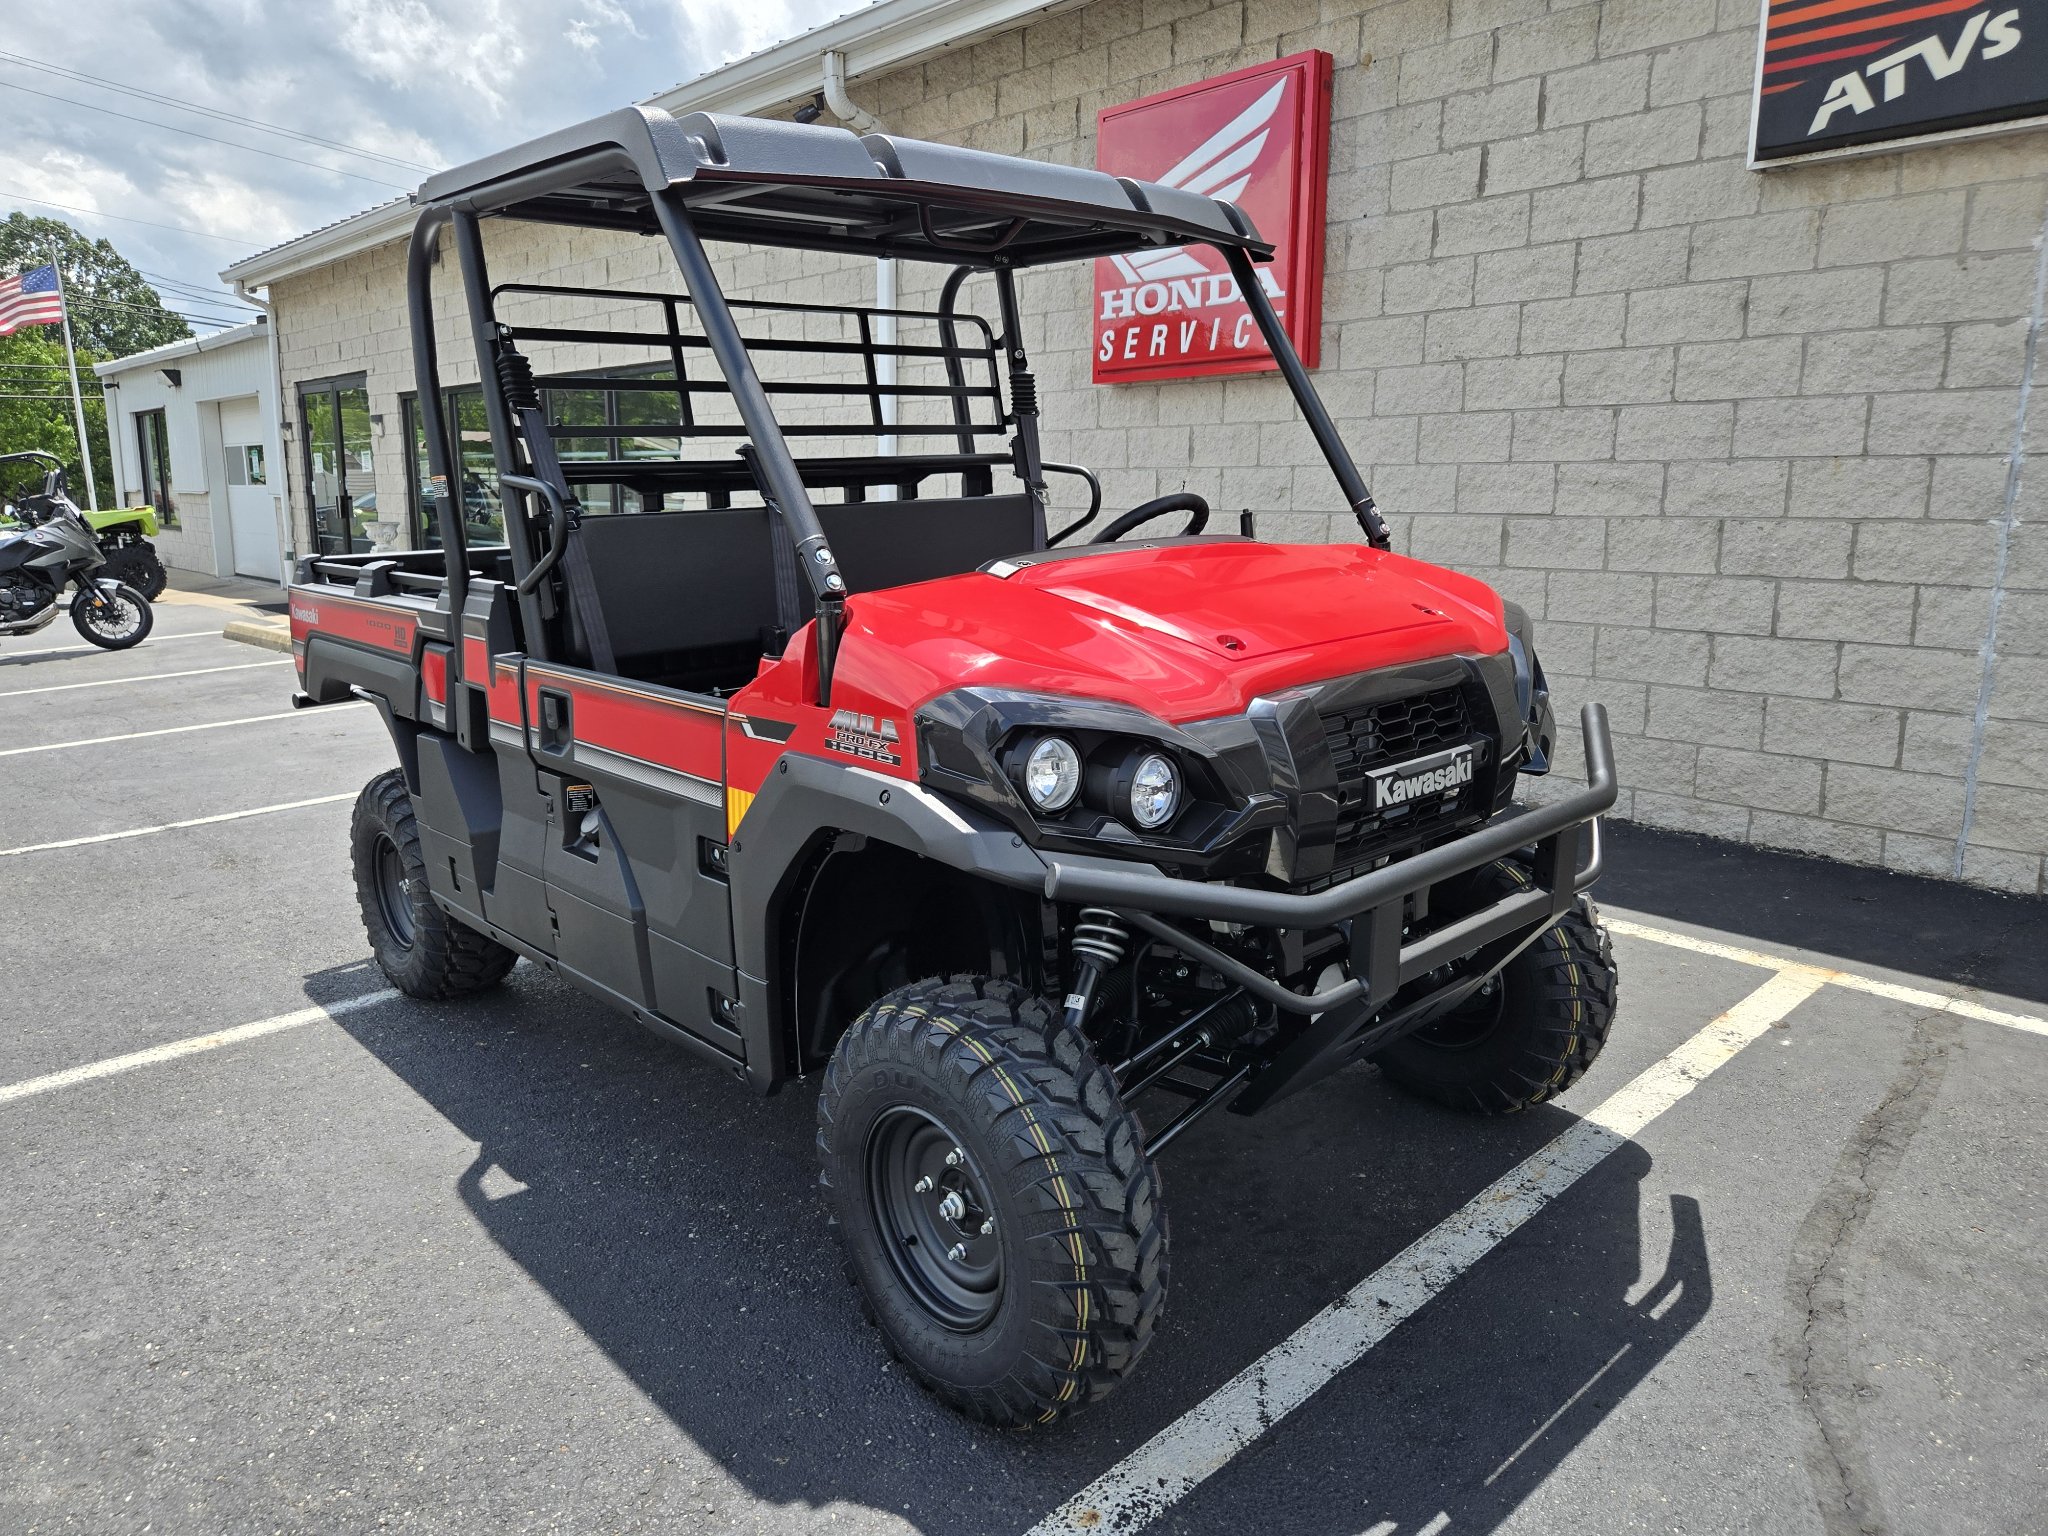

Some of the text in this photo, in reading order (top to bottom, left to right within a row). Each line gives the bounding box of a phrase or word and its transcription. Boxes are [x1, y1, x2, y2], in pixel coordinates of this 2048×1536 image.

[1100, 267, 1285, 320] HONDA
[1099, 311, 1285, 362] SERVIC
[292, 603, 319, 624] Kawasaki
[827, 709, 900, 744] MULE
[831, 740, 894, 764] 1000
[1376, 753, 1472, 808] Kawasaki
